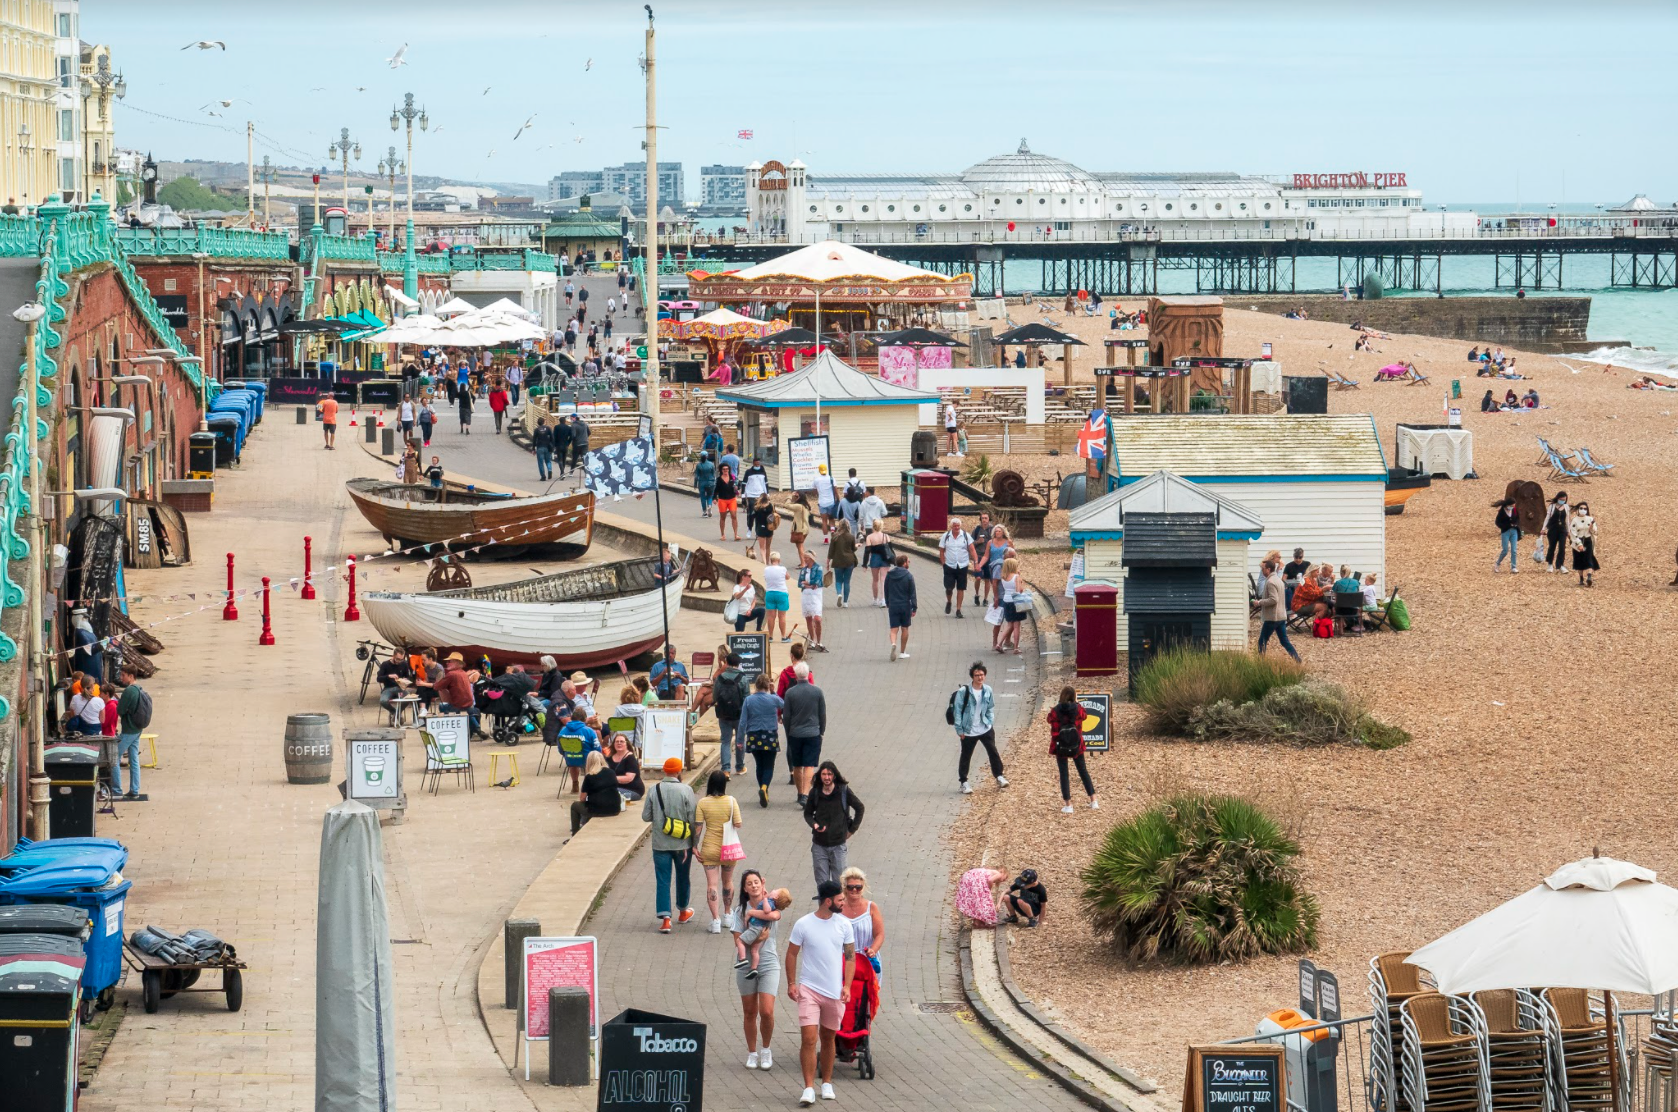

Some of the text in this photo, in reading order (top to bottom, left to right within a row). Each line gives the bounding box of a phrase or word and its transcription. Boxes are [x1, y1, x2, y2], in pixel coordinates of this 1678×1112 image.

[1293, 173, 1407, 188] BRIGHTON PIER
[139, 519, 149, 552] SM85
[431, 720, 461, 729] COFFEE
[288, 744, 331, 756] COFFEE
[356, 744, 390, 754] COFFEE
[633, 1027, 697, 1052] Tobacco
[1212, 1060, 1268, 1081] BUCCANEER
[604, 1070, 690, 1103] ALCOHOL
[1209, 1091, 1271, 1102] DRAUGHT BEER
